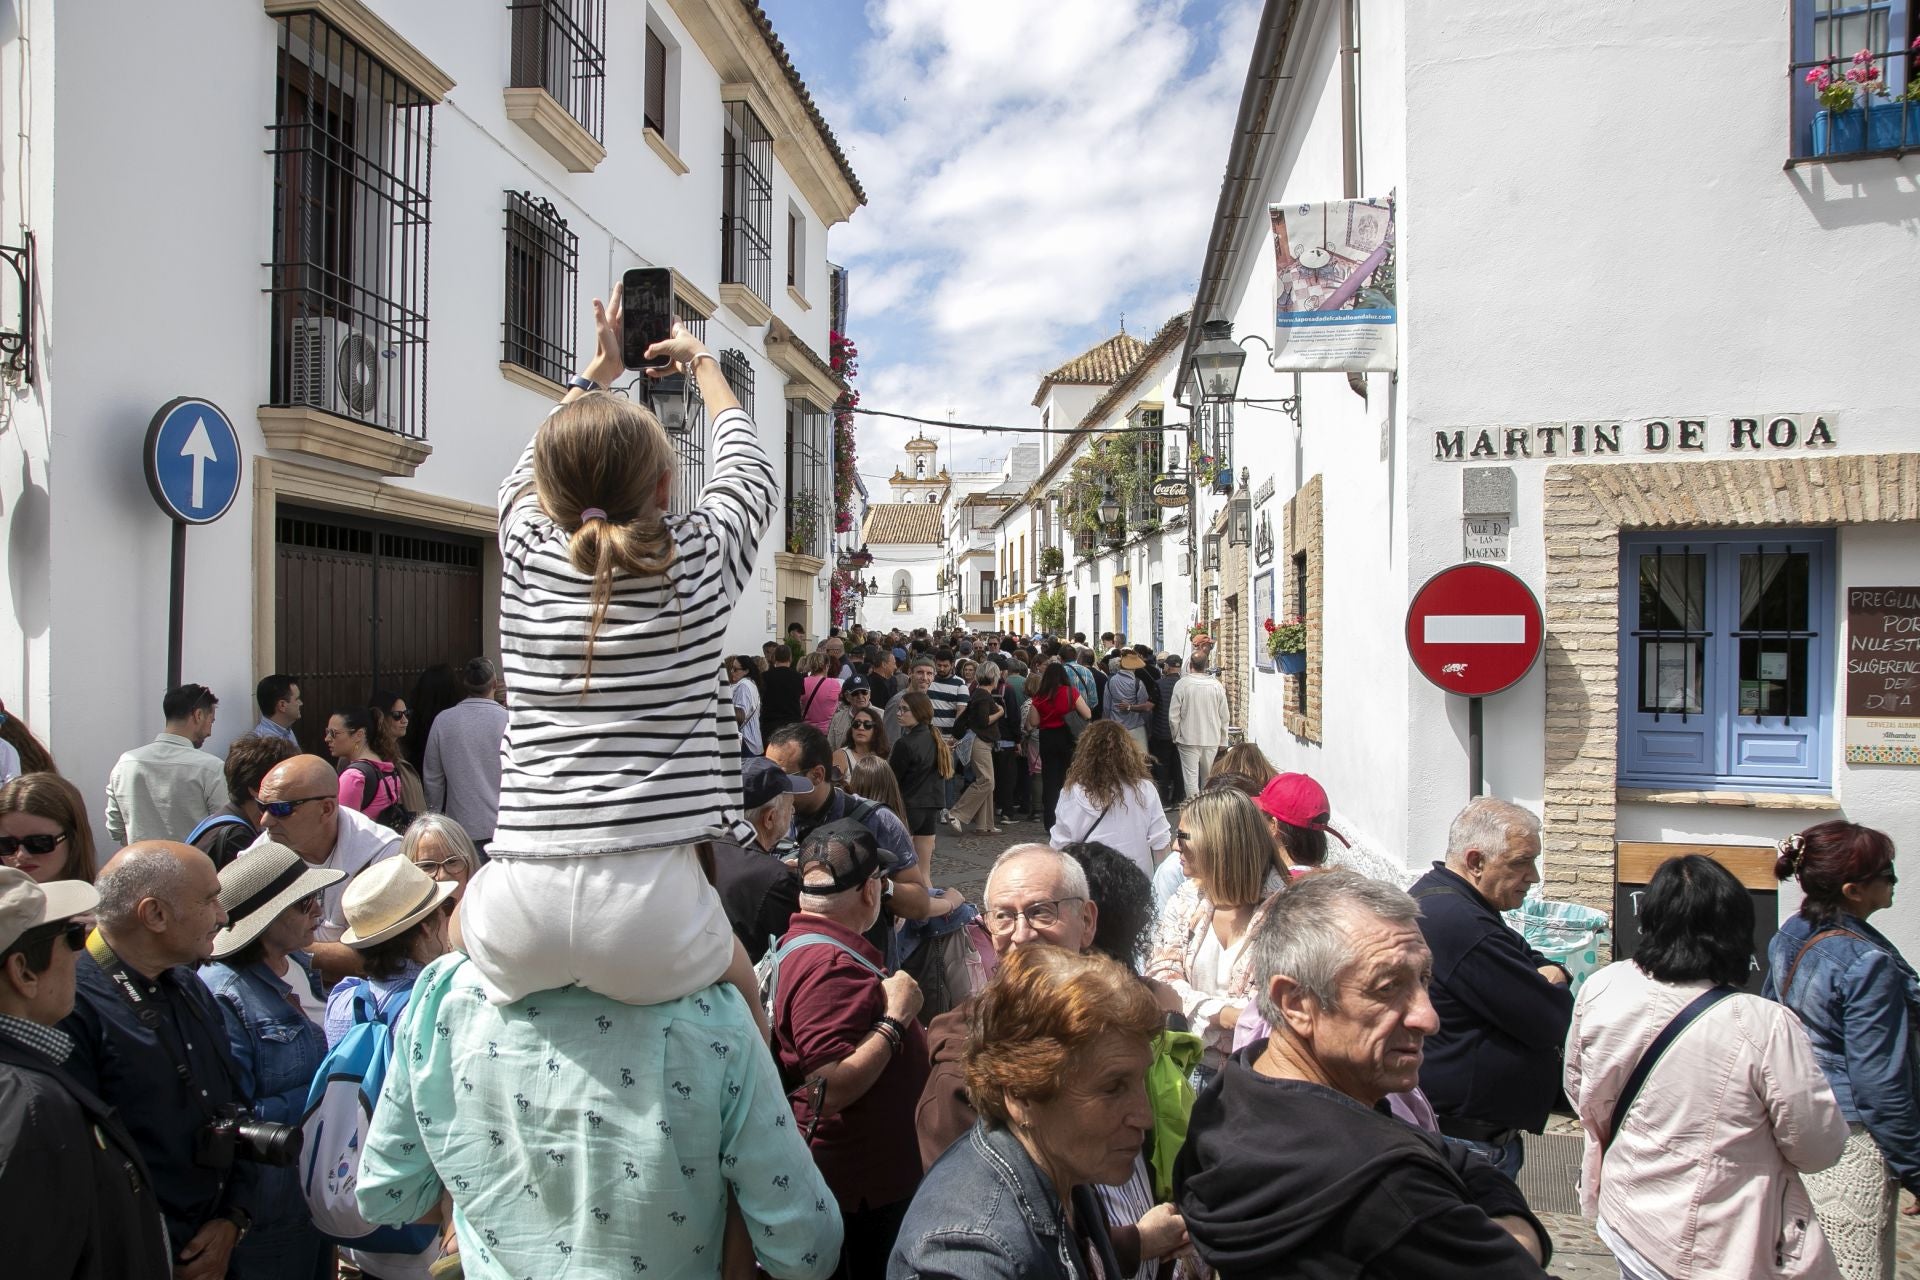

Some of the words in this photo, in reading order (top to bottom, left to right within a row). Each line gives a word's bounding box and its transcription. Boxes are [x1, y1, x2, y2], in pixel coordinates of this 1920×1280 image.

[1278, 314, 1392, 323] www.laposadadelcaballoandaluz.com
[1435, 424, 1622, 458] MARTIN
[1644, 420, 1706, 451] DE
[1730, 416, 1836, 449] ROA
[1480, 536, 1493, 544] LAS
[1465, 546, 1506, 558] IMAGENES
[123, 981, 142, 1002] Nikon
